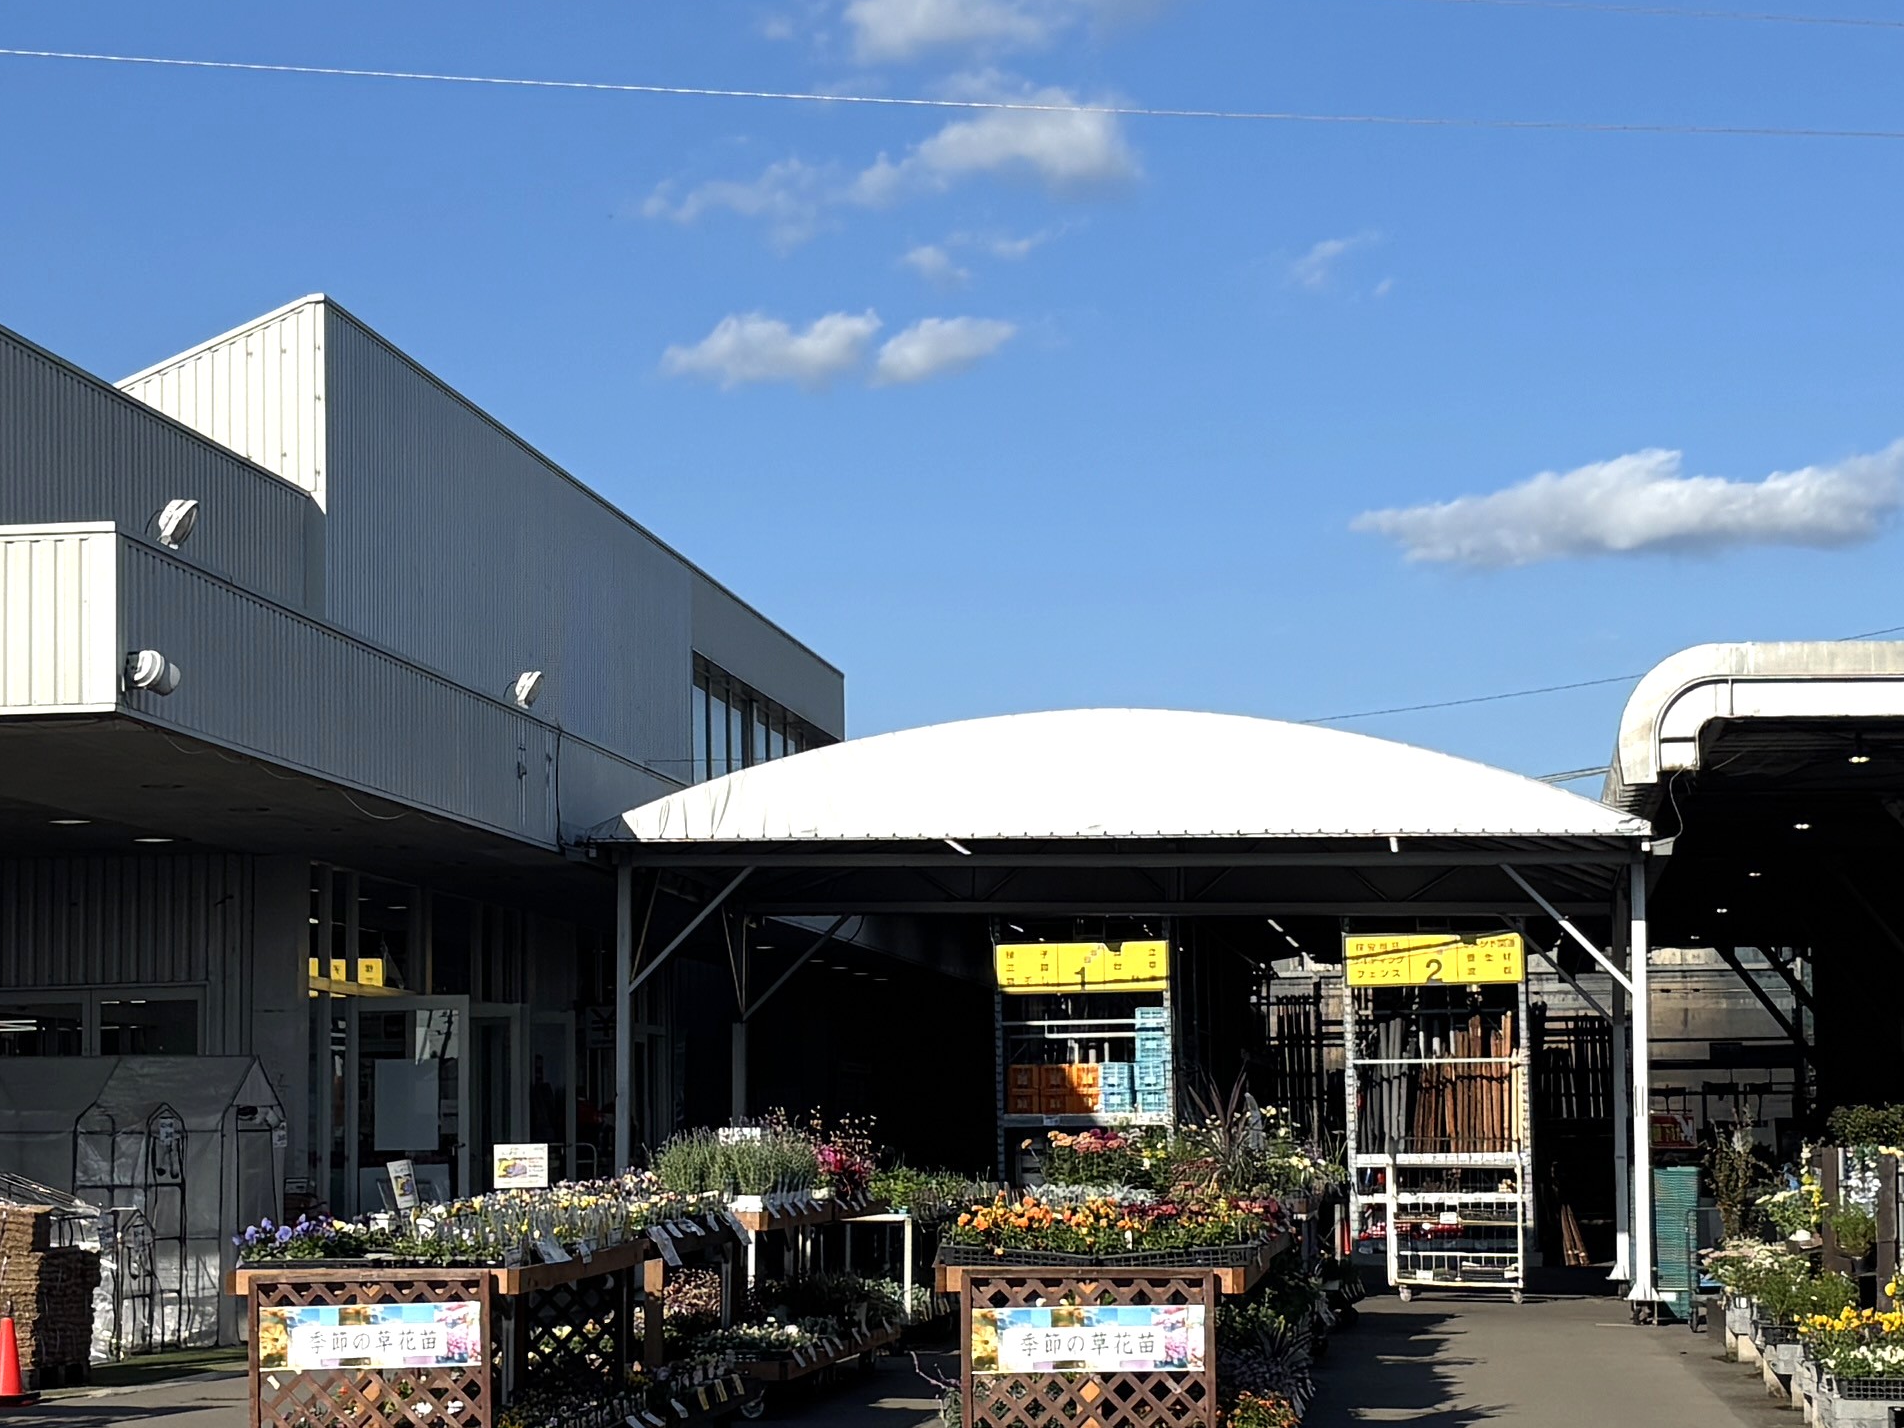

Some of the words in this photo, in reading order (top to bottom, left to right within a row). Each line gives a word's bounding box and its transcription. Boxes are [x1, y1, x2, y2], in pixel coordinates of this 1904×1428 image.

[1074, 966, 1086, 991] 1
[1425, 958, 1444, 983] 2
[310, 1330, 437, 1354] 季節の草花苗
[1020, 1332, 1155, 1356] 季節の草花苗
